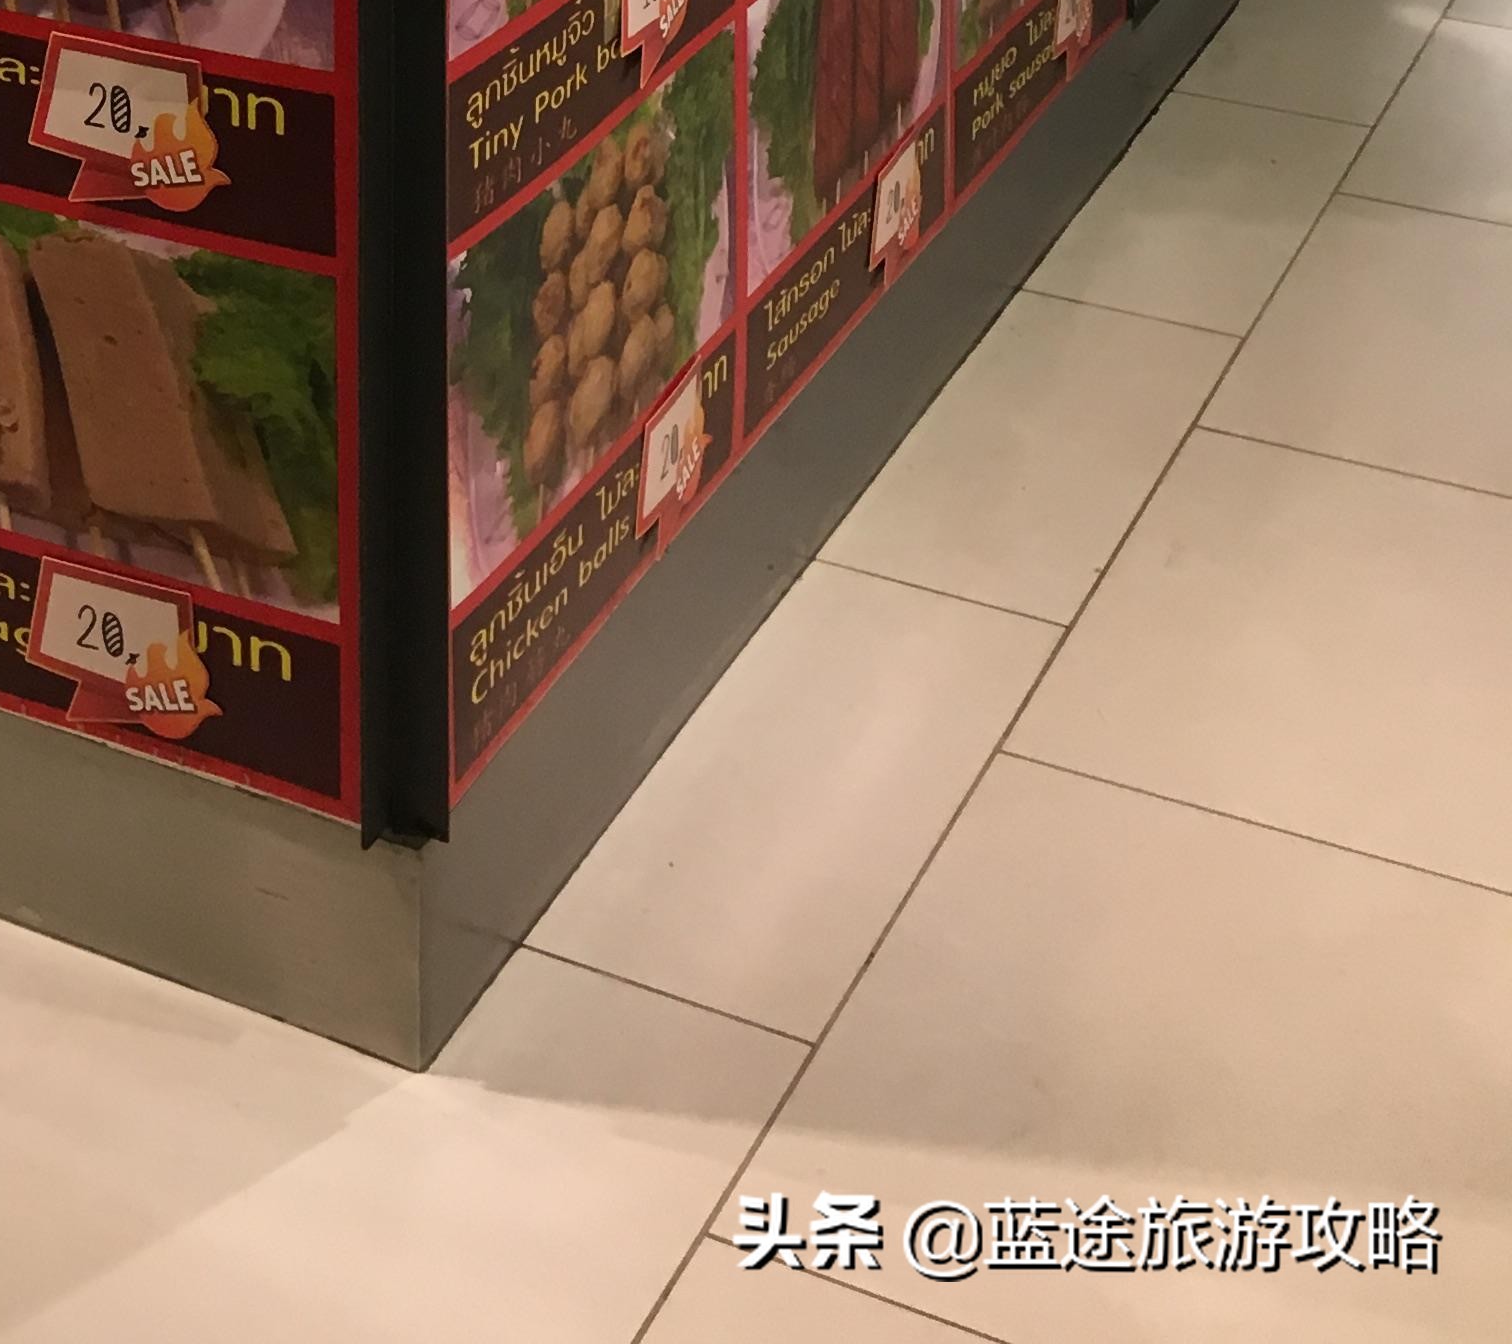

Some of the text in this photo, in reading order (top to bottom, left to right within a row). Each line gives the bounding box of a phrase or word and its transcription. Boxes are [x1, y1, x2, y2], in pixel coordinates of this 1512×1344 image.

[468, 114, 525, 170] Tiny
[534, 62, 589, 124] Pork
[972, 91, 1005, 141] Pork
[130, 149, 202, 188] SALE
[766, 278, 841, 372] Sausage
[676, 437, 701, 501] SALE
[469, 516, 629, 706] Chicken balls
[125, 677, 195, 713] SALE
